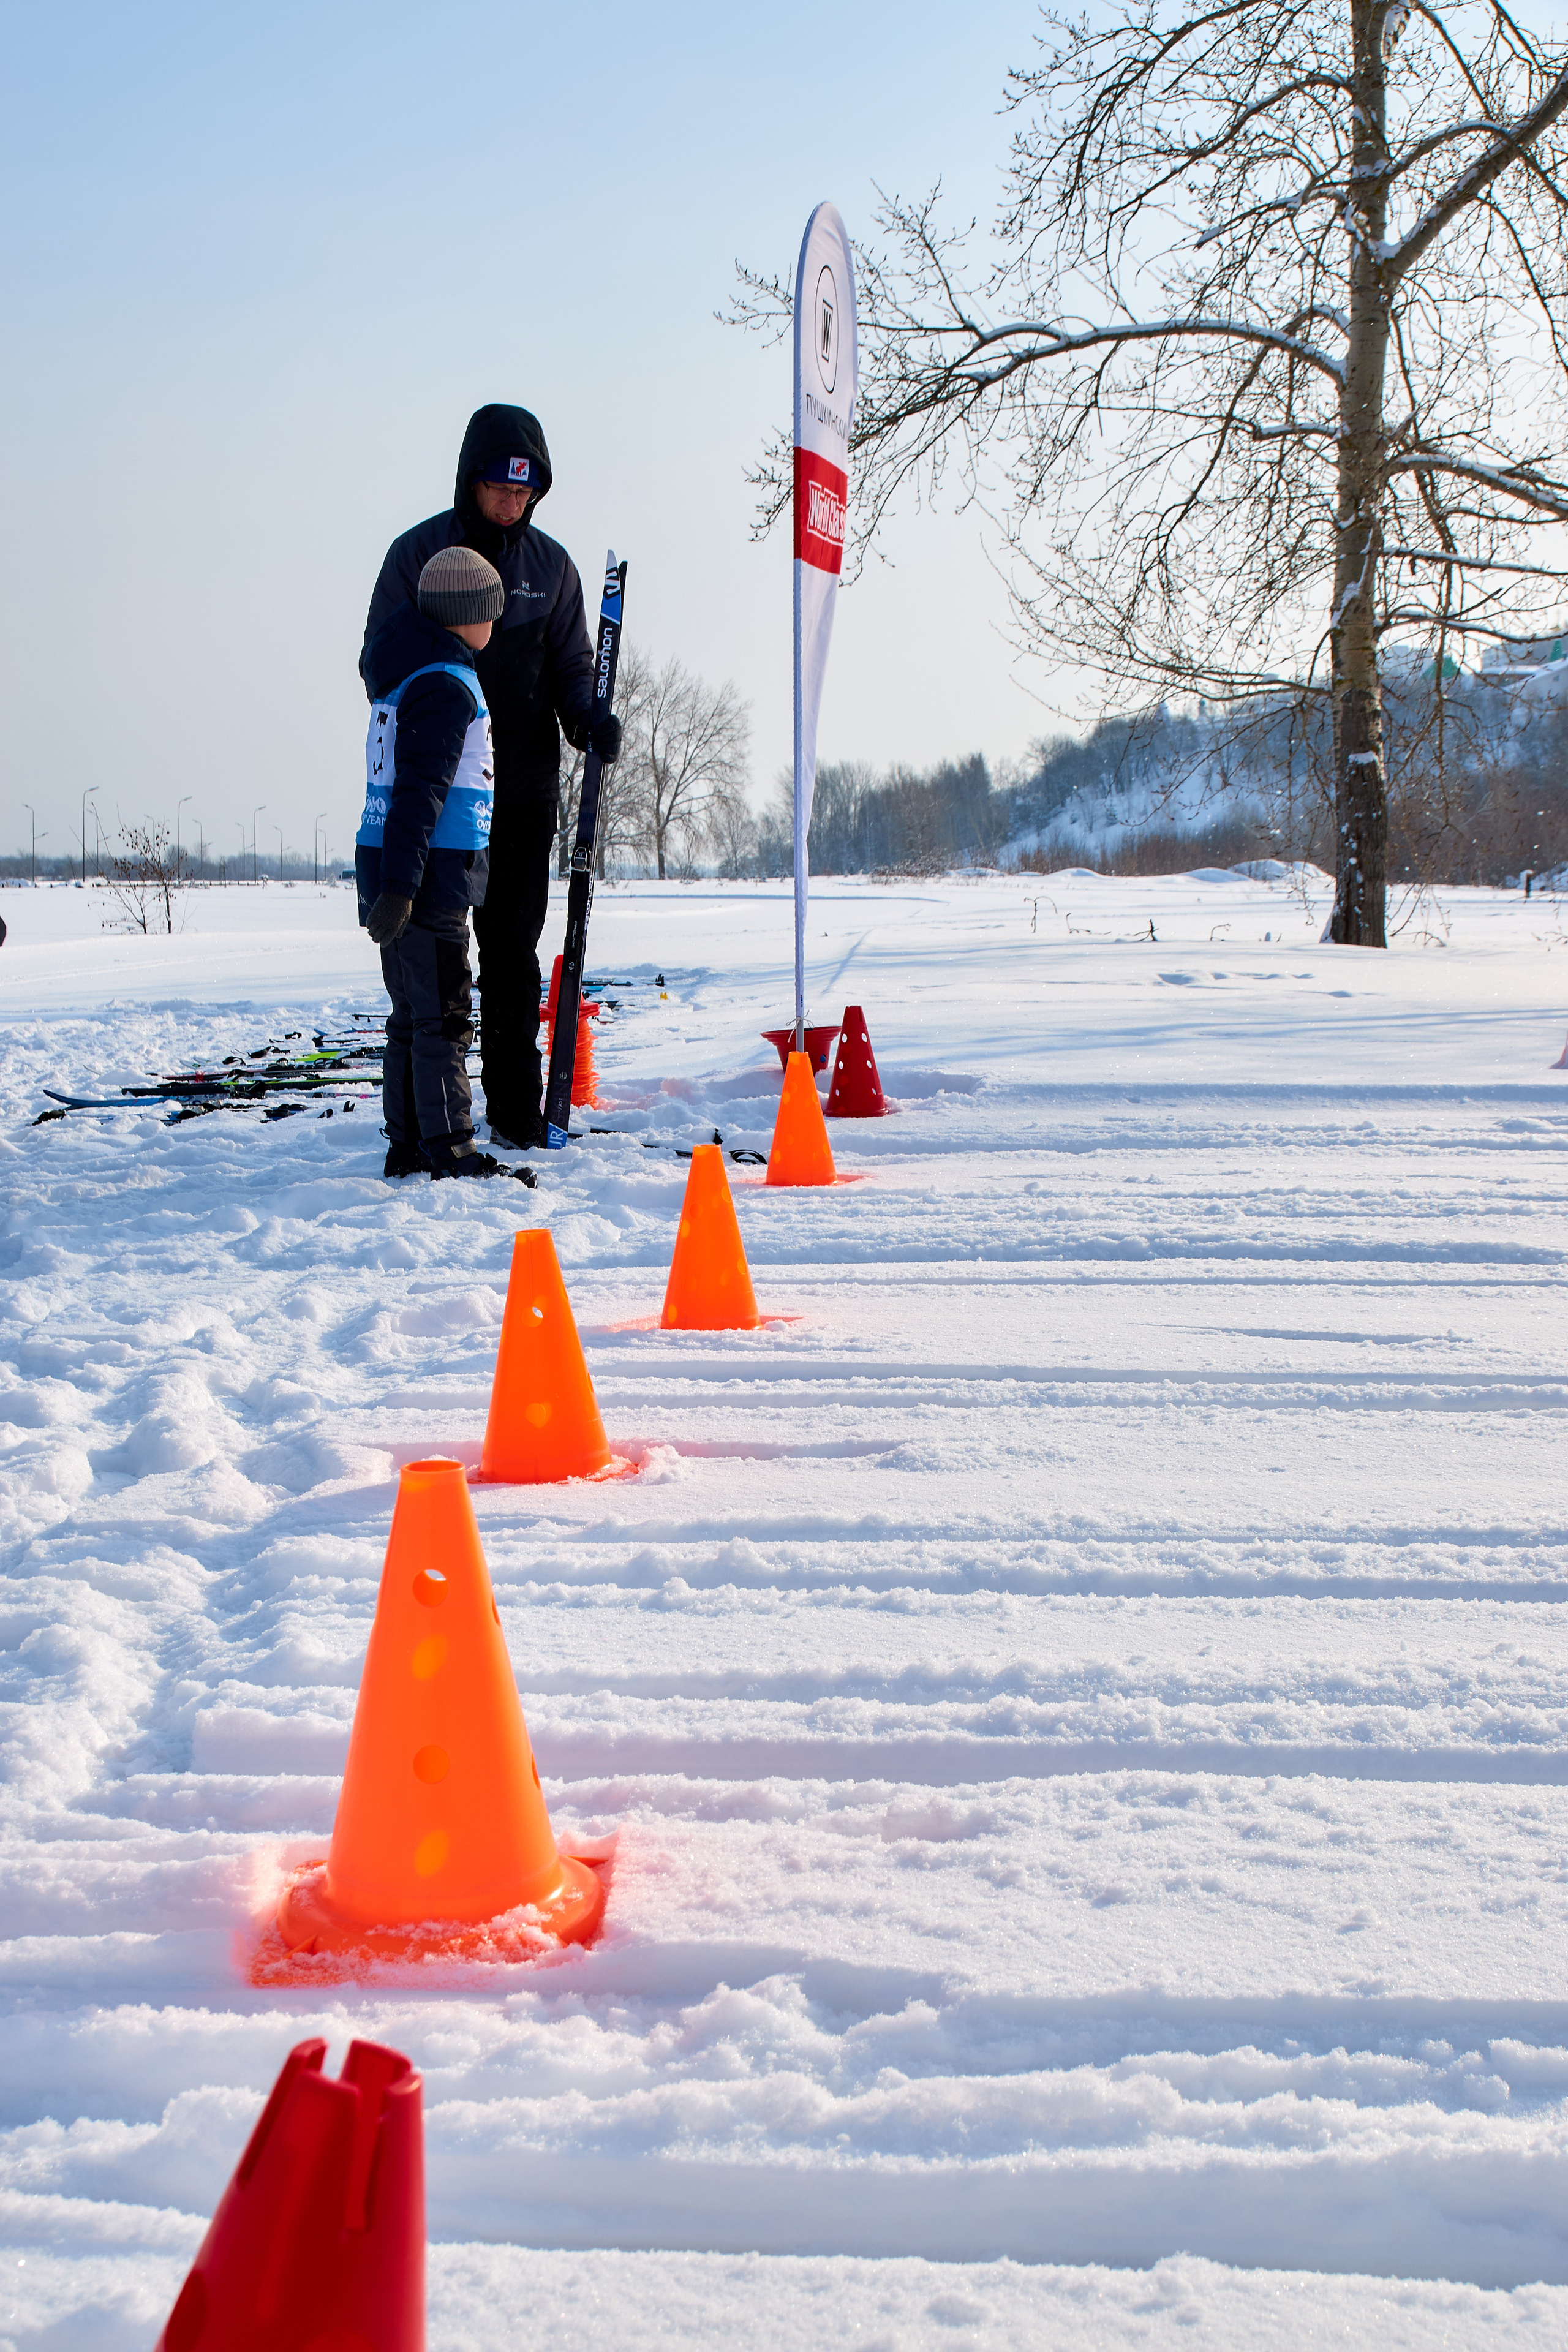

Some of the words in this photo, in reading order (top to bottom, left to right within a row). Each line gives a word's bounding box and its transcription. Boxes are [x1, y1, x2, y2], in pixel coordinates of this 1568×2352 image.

[806, 393, 846, 440] ПУШКИНСКИ
[511, 589, 546, 598] NORDSKI
[597, 627, 613, 698] salomon
[549, 1131, 564, 1148] JR
